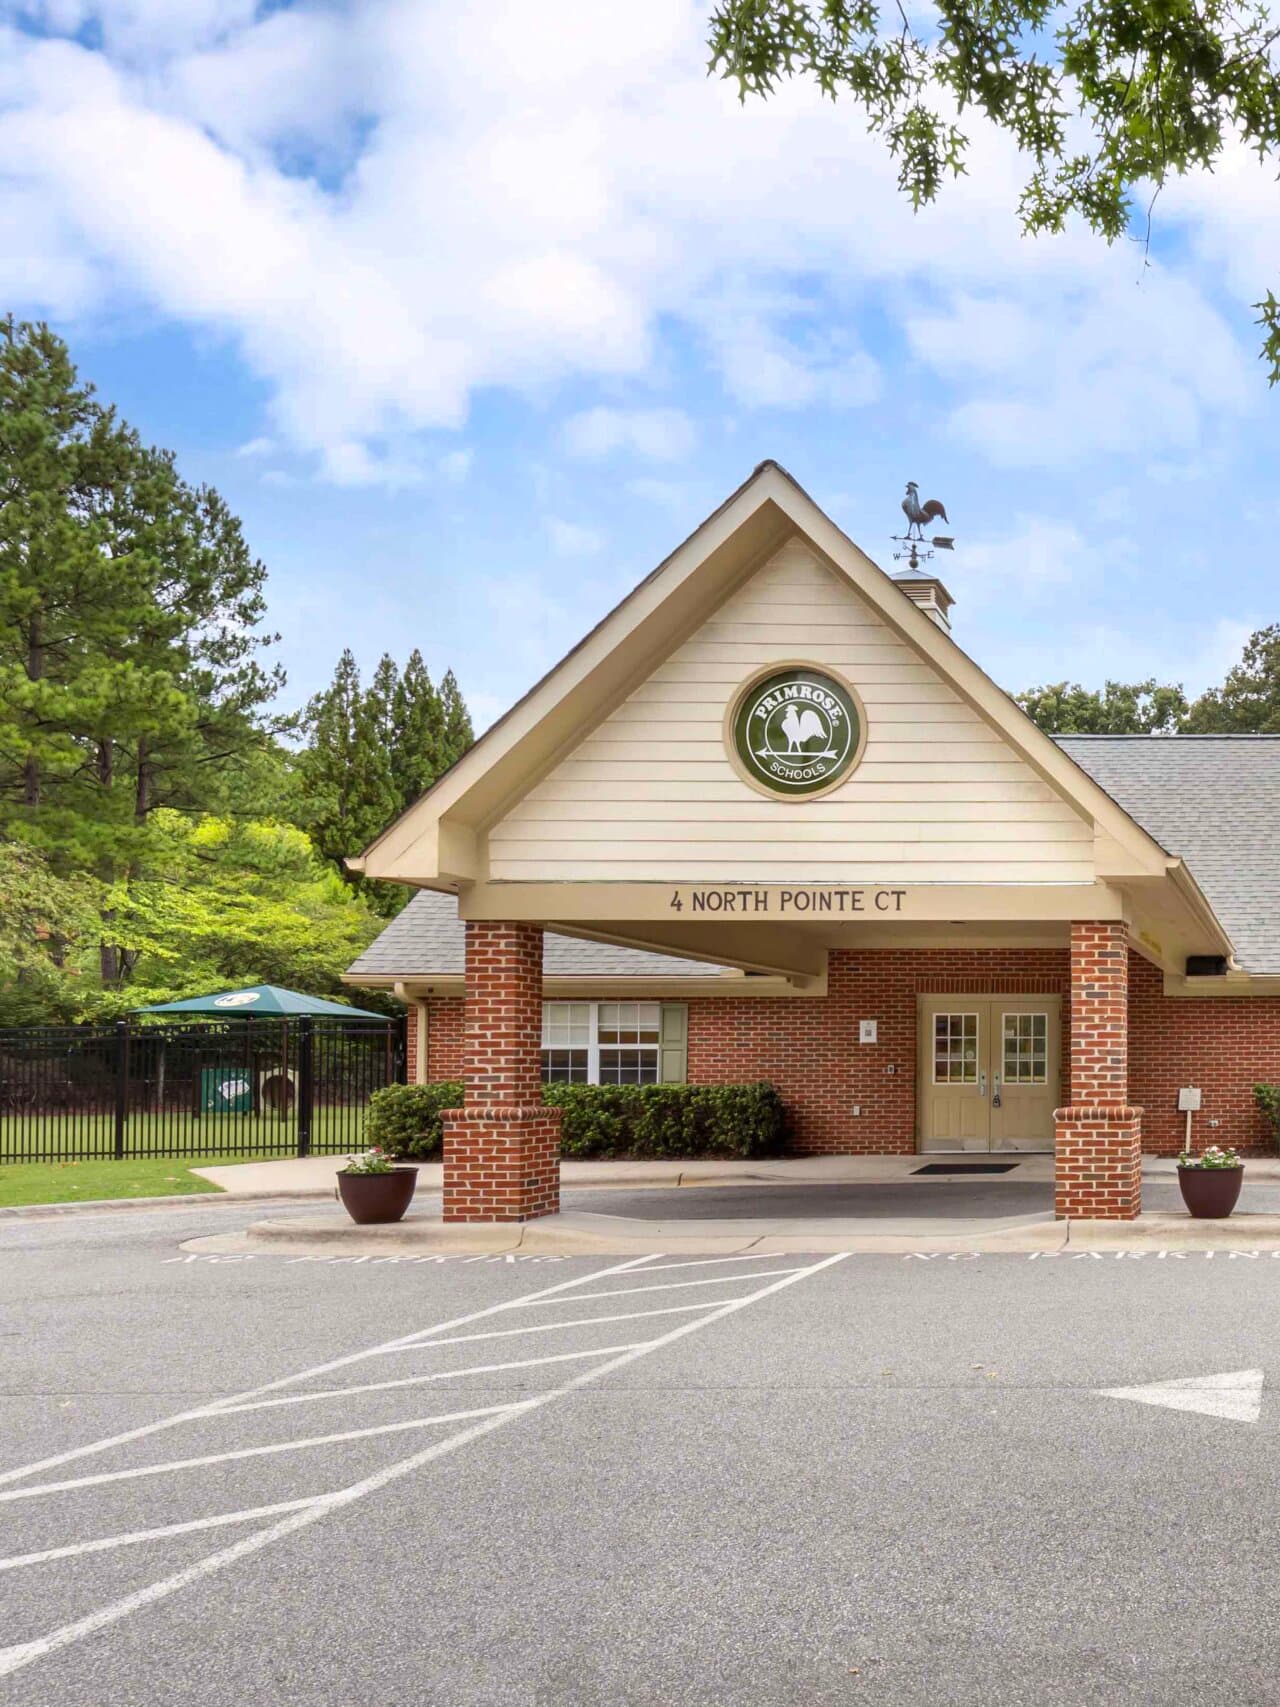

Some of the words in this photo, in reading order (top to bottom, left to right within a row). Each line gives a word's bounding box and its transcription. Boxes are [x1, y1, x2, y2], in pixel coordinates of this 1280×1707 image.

[755, 685, 842, 720] PRIMROSE
[770, 761, 826, 780] SCHOOLS
[670, 890, 683, 911] 4
[692, 891, 768, 911] NORTH
[780, 891, 864, 911] POINTE
[874, 891, 906, 911] CT
[903, 1252, 982, 1261] NO
